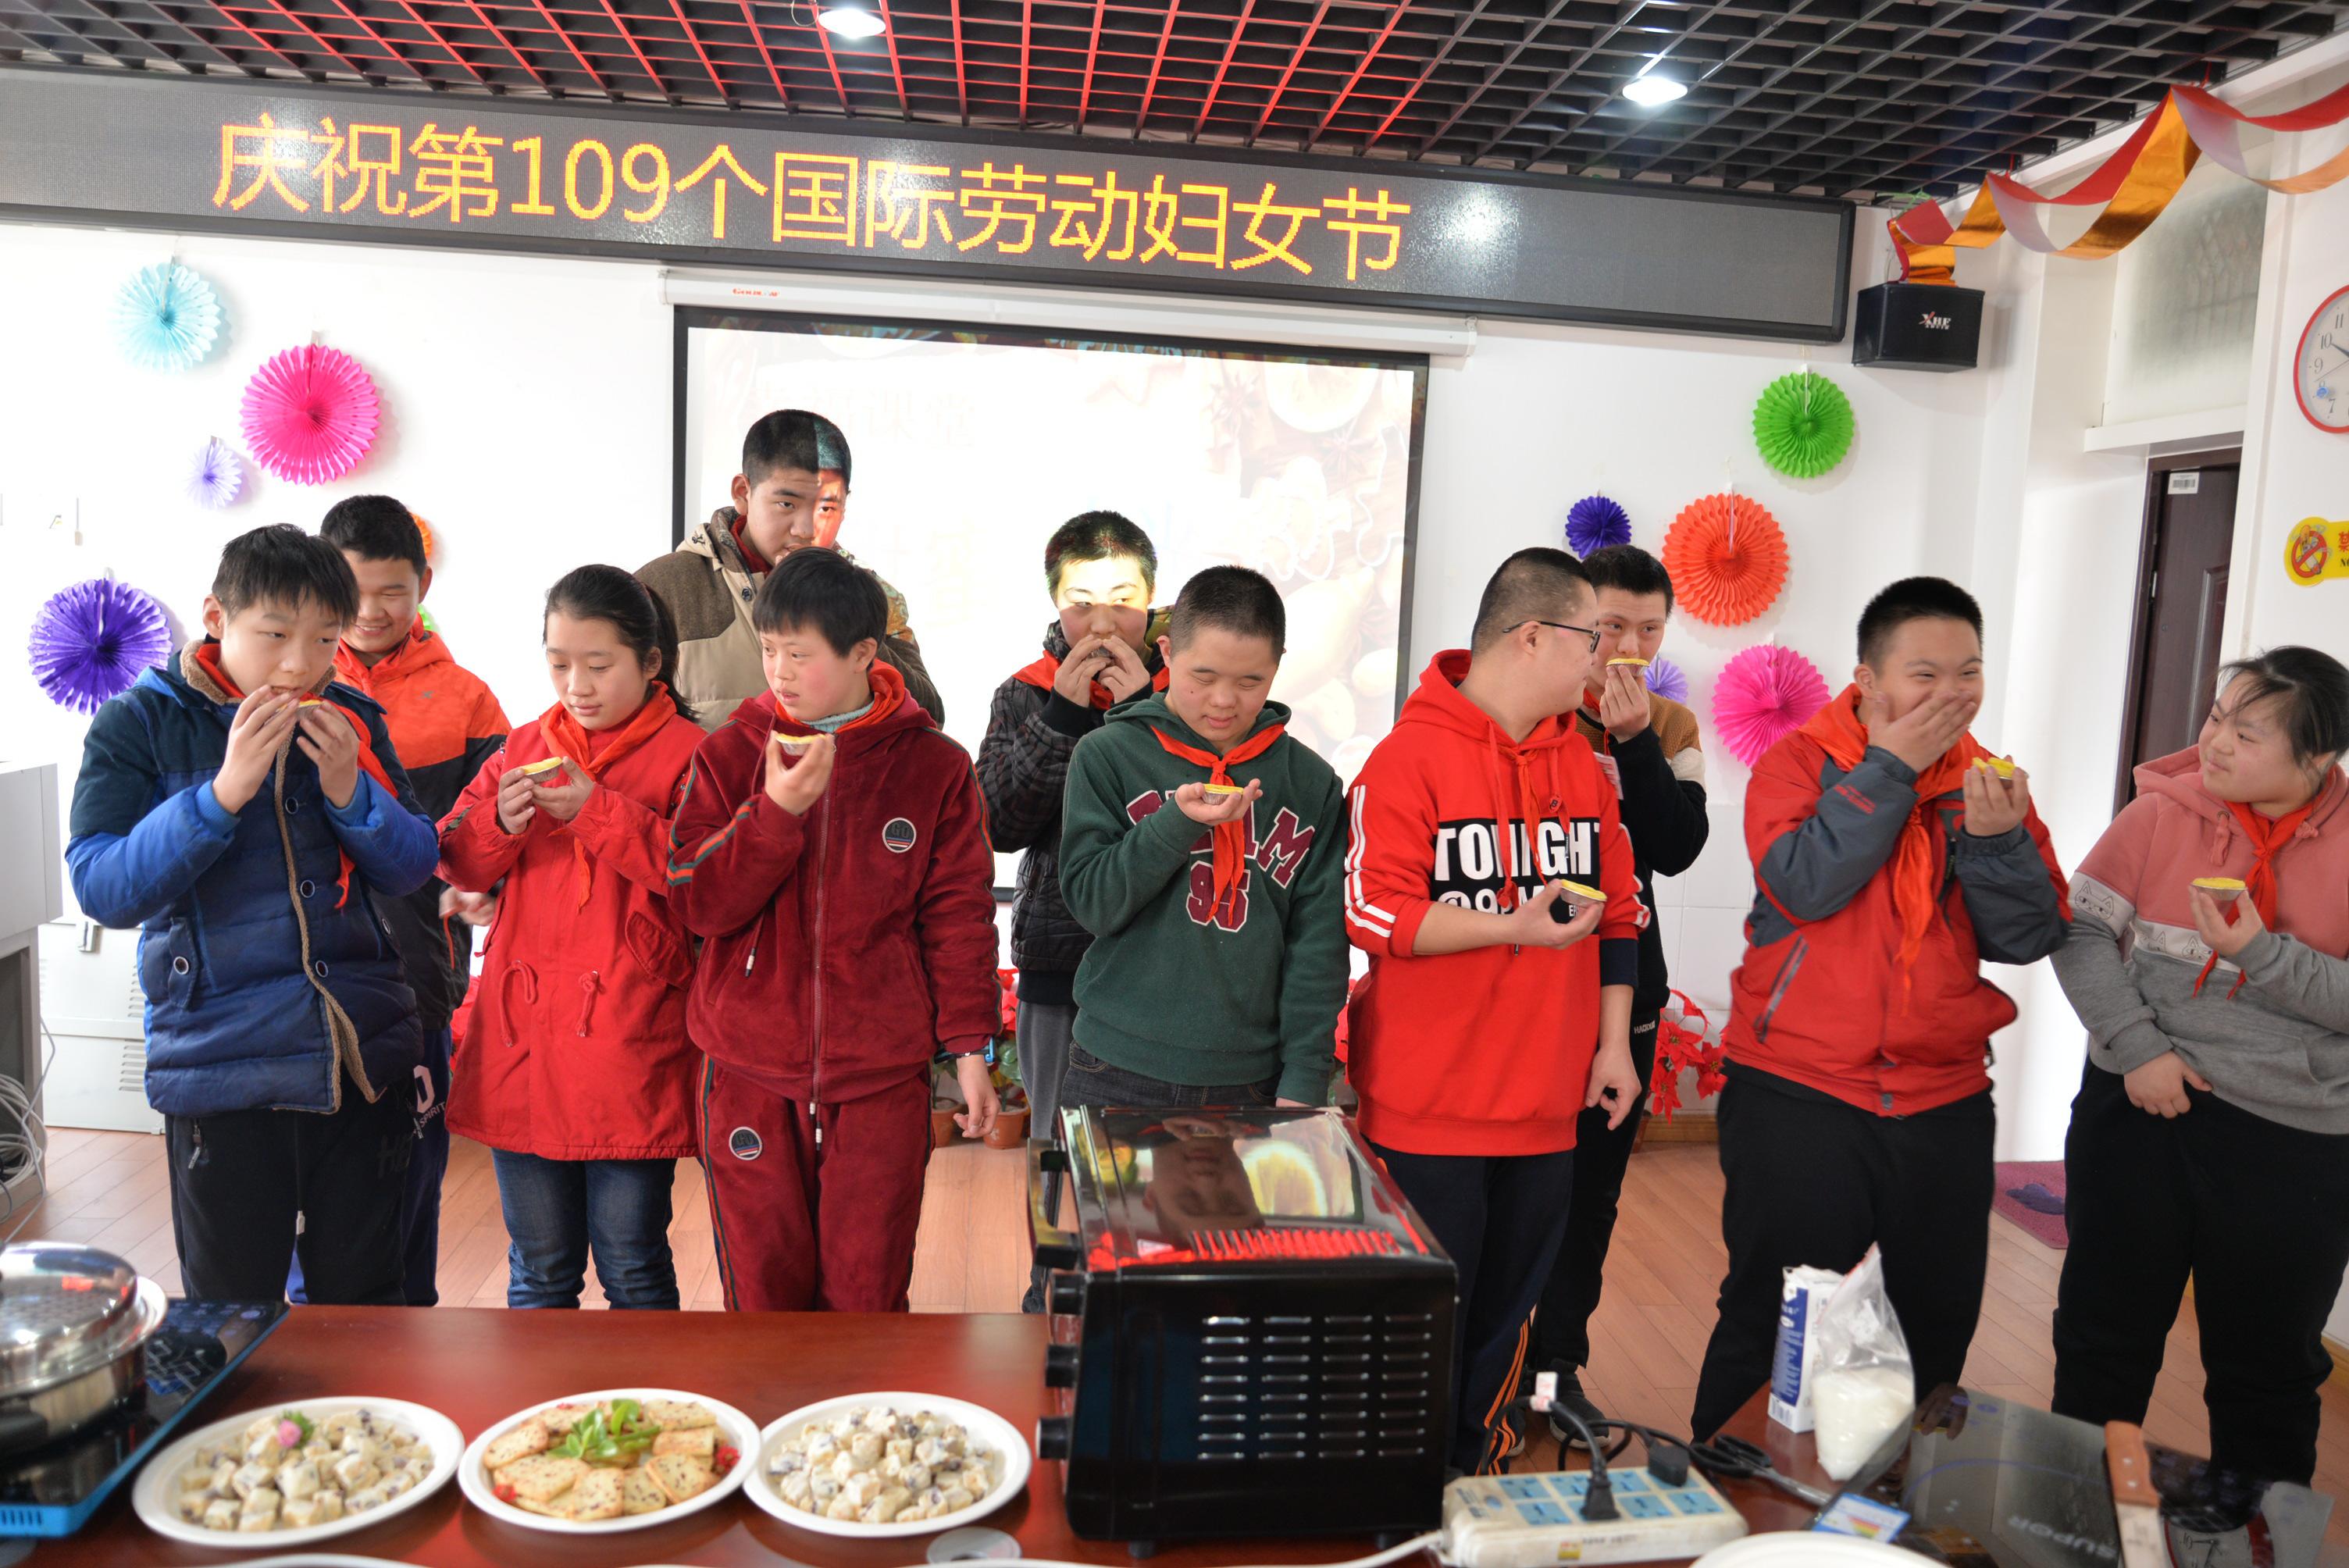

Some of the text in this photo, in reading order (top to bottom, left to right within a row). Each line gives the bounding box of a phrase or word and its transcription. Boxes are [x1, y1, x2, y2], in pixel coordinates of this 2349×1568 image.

[212, 112, 1411, 281] 庆祝第109个国际劳动妇女节
[2335, 313, 2344, 329] 11
[2321, 332, 2333, 350] 10
[2314, 357, 2323, 373] 9
[2328, 397, 2336, 414] 7
[1435, 821, 1599, 882] TONIGH
[419, 1102, 446, 1128] SPIRIT
